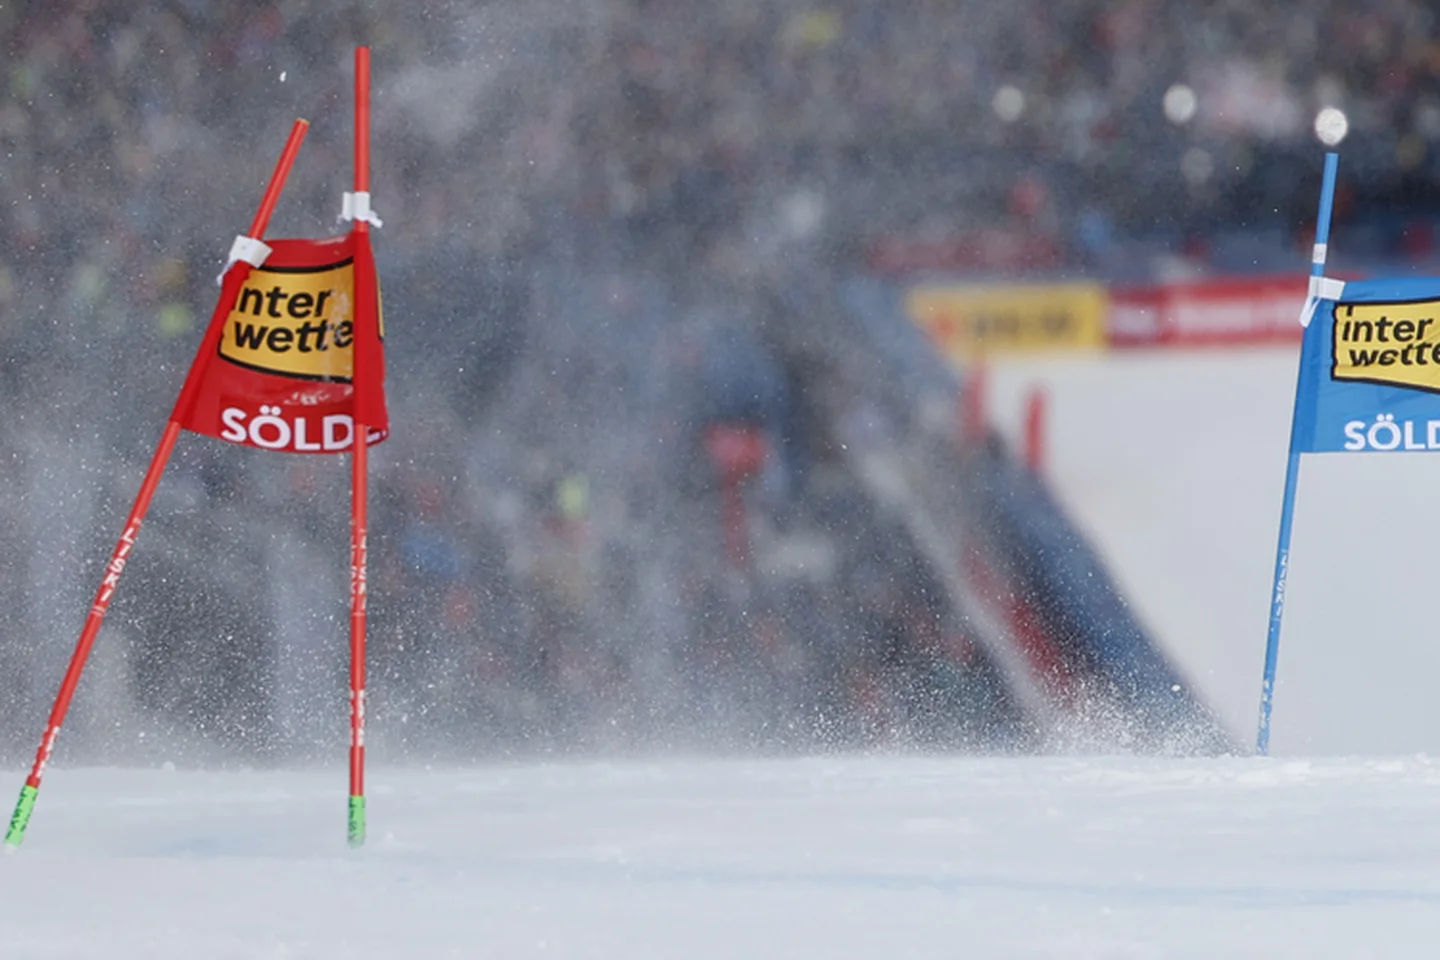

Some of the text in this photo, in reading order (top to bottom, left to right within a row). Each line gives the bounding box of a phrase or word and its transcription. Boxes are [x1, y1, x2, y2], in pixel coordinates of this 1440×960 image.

[233, 286, 333, 319] nter
[234, 319, 354, 353] wette
[1342, 307, 1434, 343] inter
[221, 405, 388, 451] SÖLD
